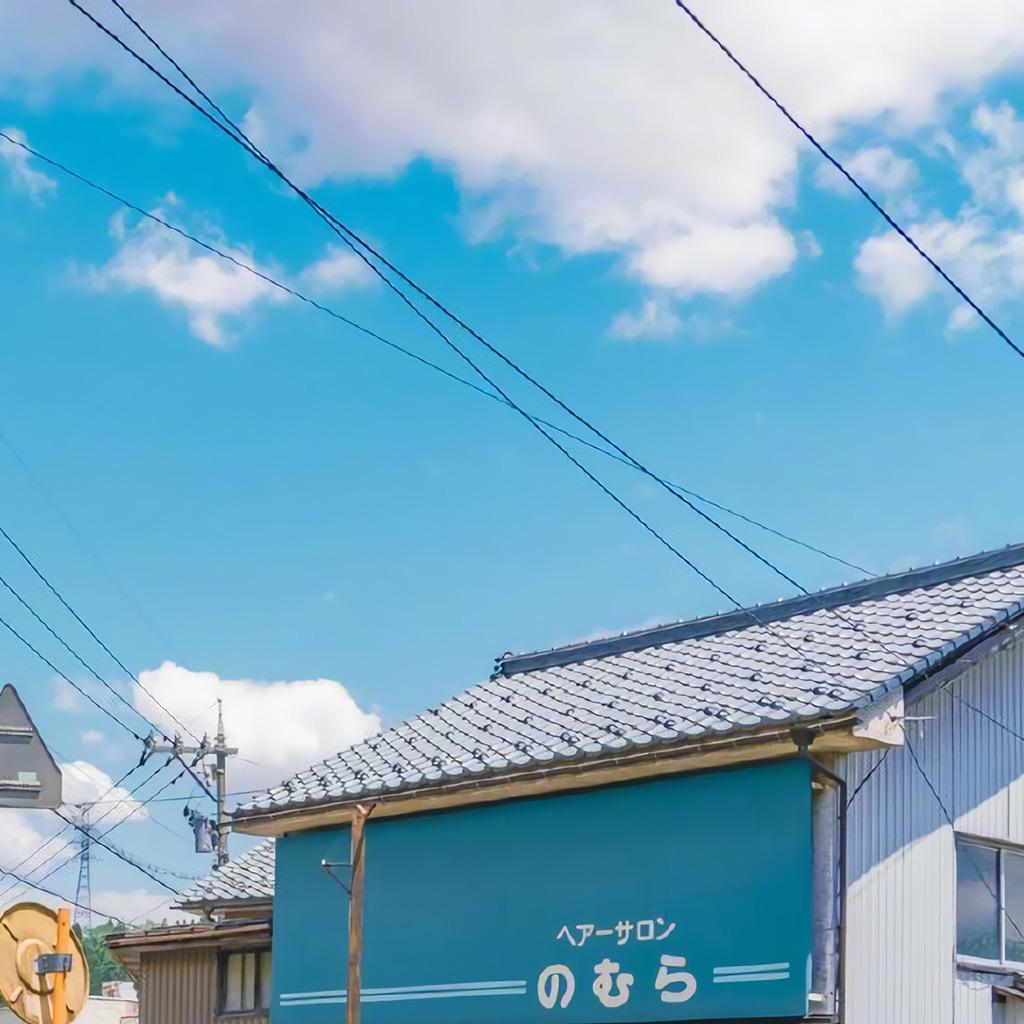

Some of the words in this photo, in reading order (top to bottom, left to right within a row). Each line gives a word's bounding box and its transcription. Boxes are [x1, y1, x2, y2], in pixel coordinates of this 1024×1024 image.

[556, 917, 676, 947] ヘアーサロン
[537, 954, 697, 1009] のむら
